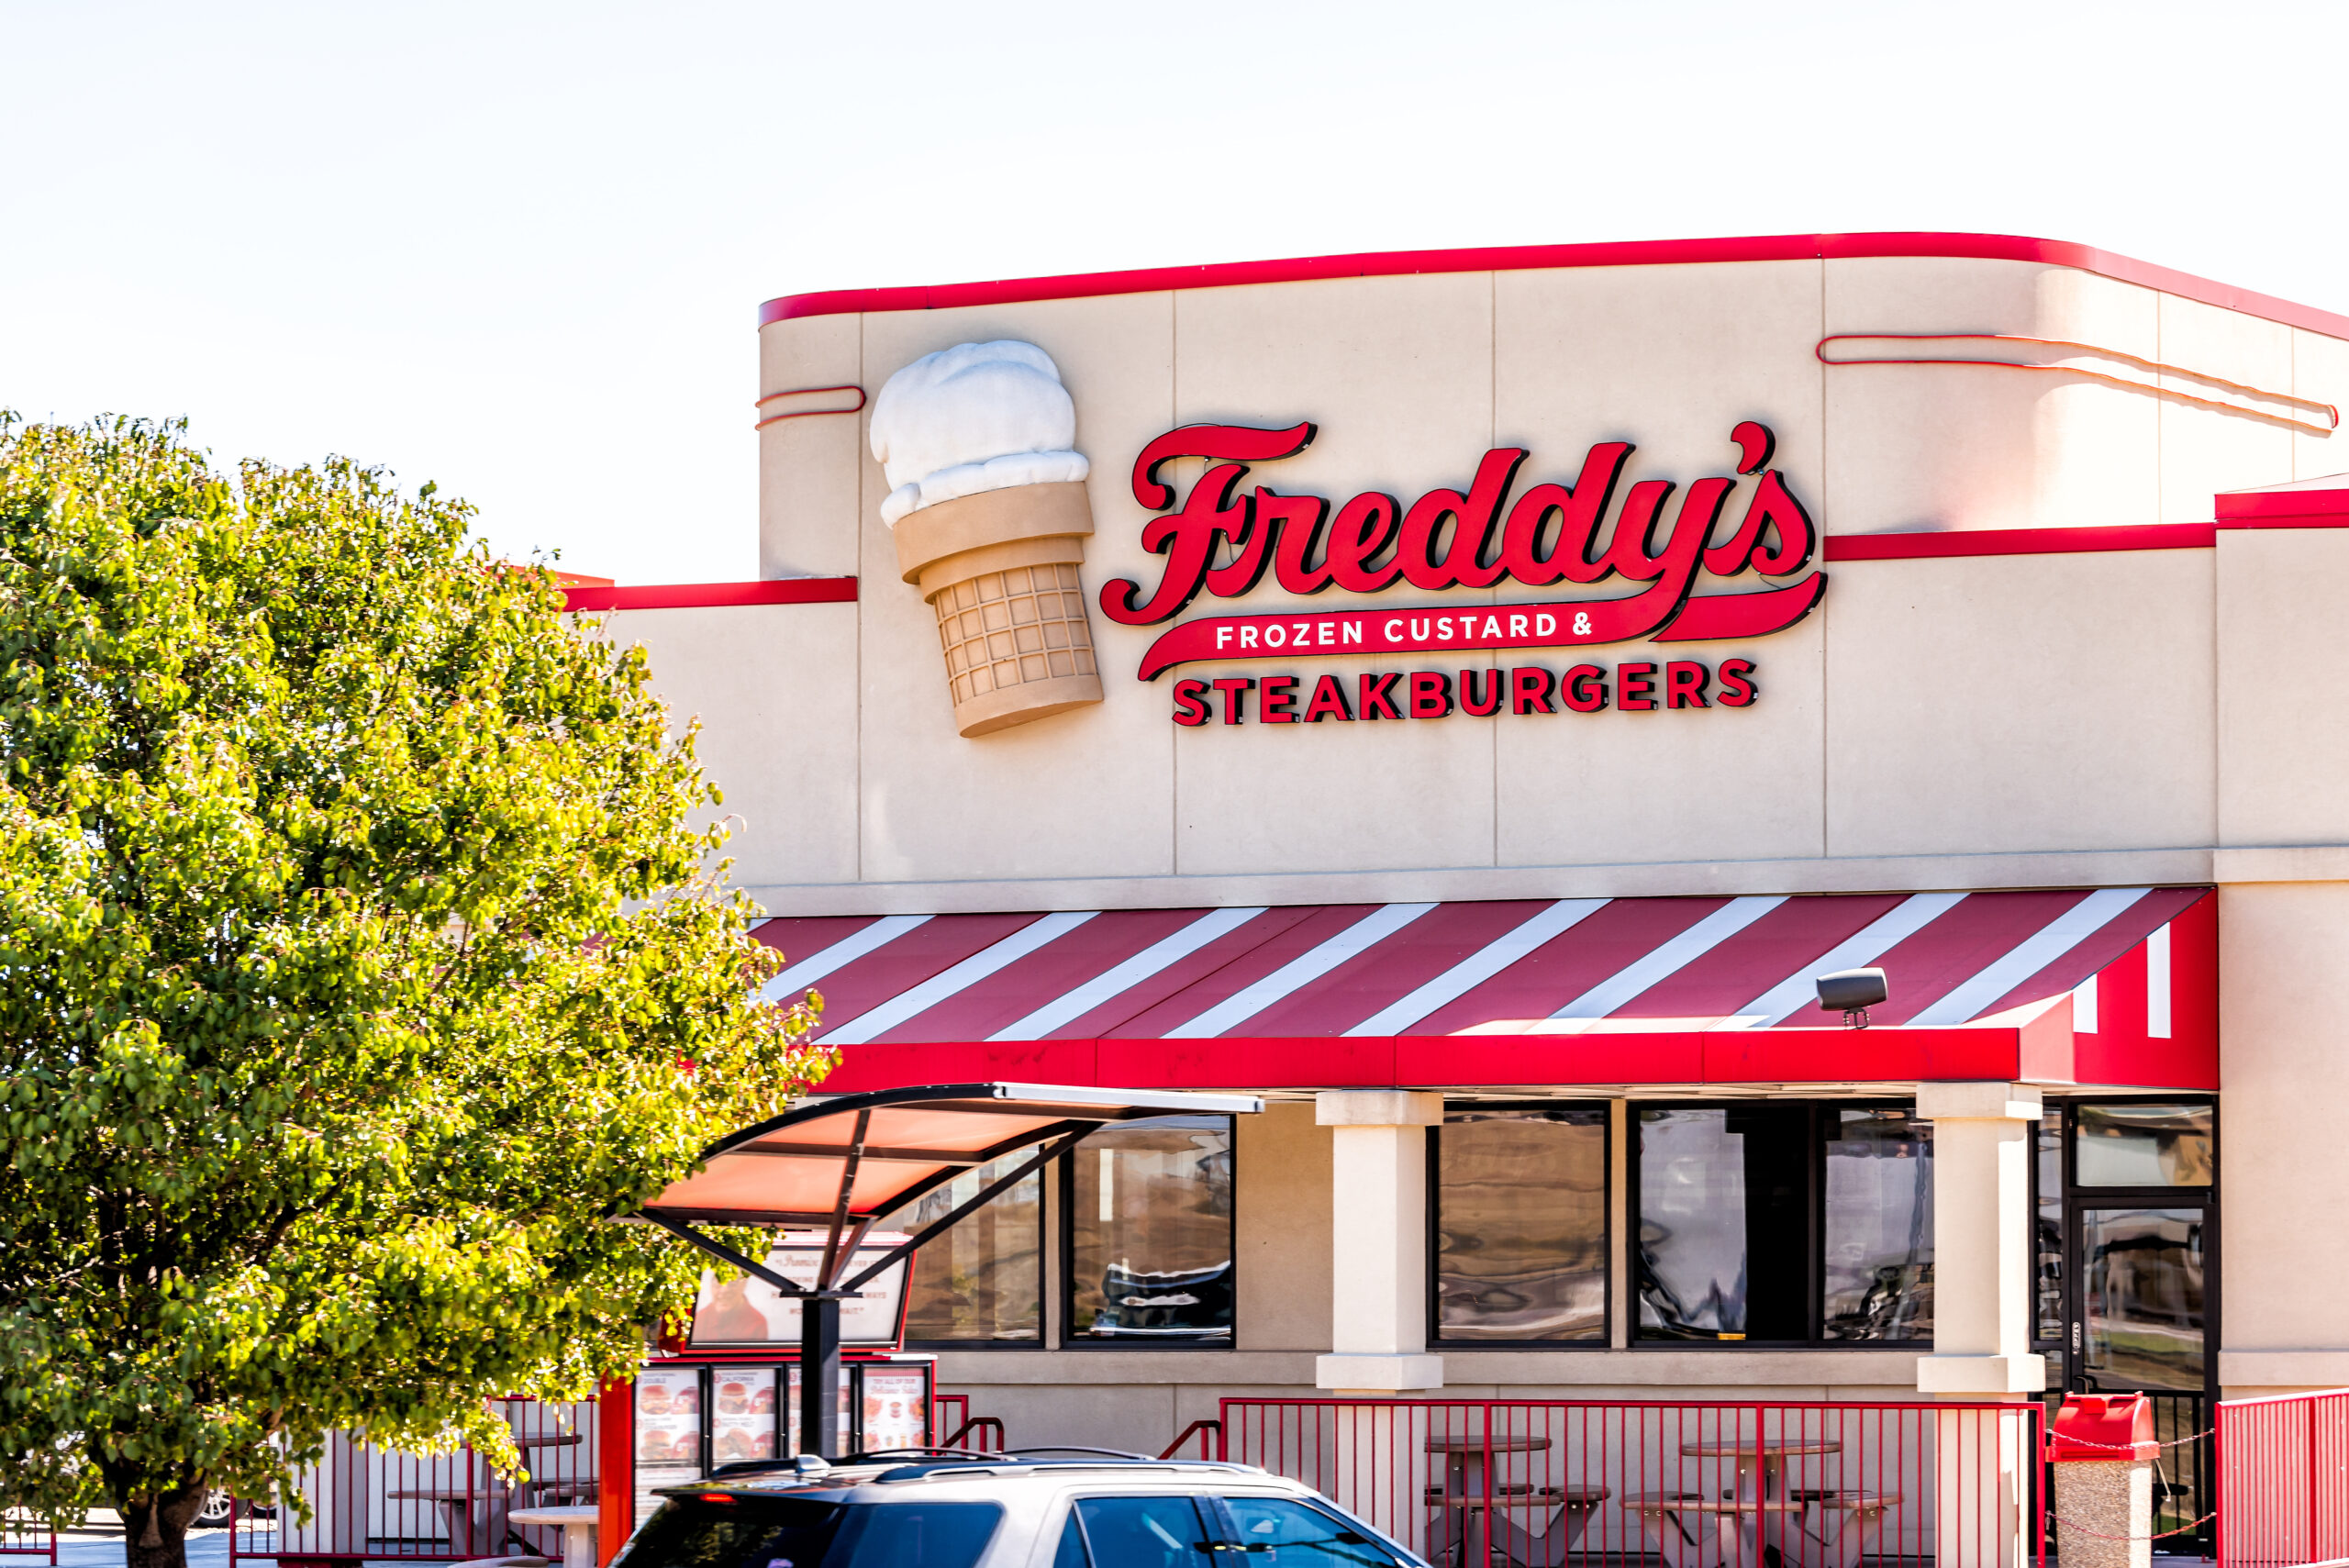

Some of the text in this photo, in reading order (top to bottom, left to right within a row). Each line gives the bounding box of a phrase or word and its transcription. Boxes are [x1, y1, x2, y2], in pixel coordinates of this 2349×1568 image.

[1100, 420, 1817, 643] Freddy's
[1217, 611, 1593, 650] FROZEN CUSTARD &
[1172, 658, 1758, 726] STEAKBURGERS
